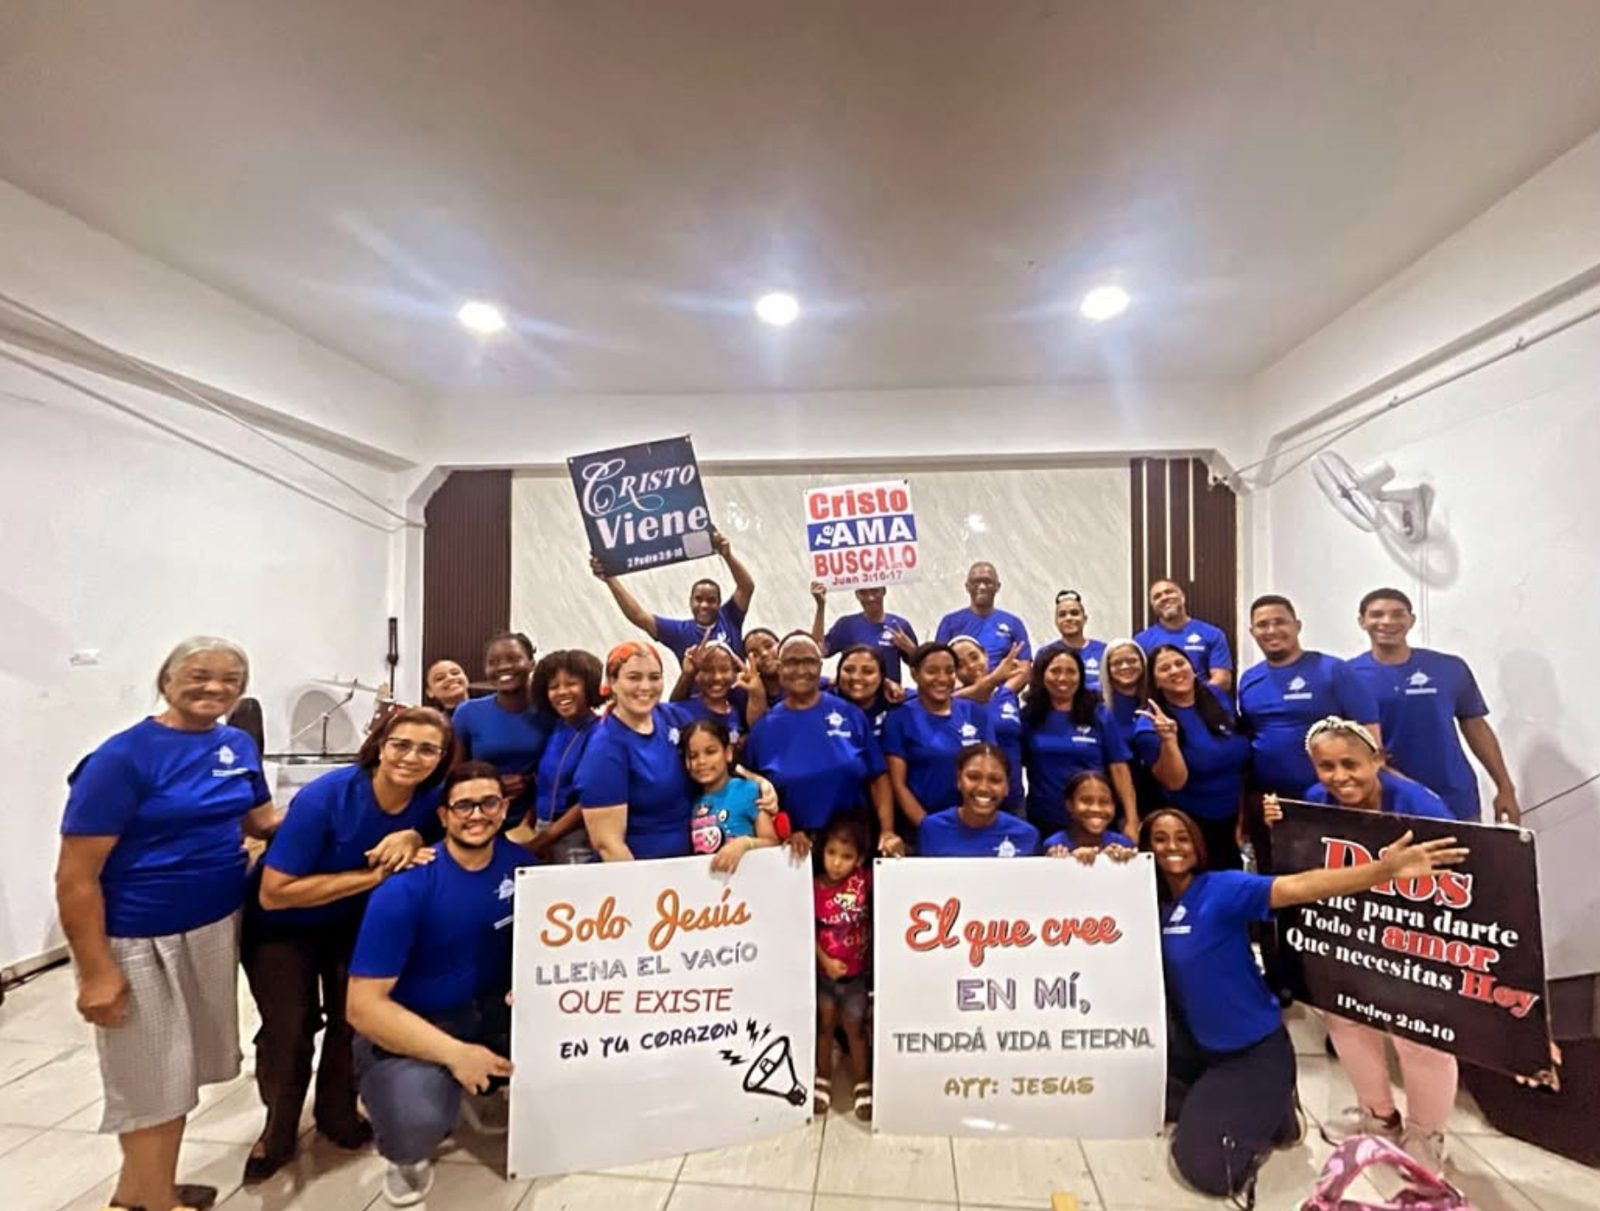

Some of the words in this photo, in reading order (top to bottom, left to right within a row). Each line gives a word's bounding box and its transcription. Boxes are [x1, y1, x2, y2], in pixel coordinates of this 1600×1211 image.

[582, 458, 696, 517] CRISTO
[809, 487, 908, 520] Cristo
[595, 506, 708, 549] Viene
[814, 525, 834, 546] Te
[831, 516, 914, 547] AMA
[814, 544, 917, 578] BUSCALO
[832, 575, 860, 586] Juan
[1320, 836, 1474, 909] Dos
[540, 896, 632, 948] Solo
[648, 887, 751, 952] Jesús
[904, 897, 960, 952] El
[963, 916, 1036, 968] que
[1040, 914, 1122, 947] cree
[1300, 907, 1352, 937] Todo
[1356, 924, 1376, 944] el
[1381, 925, 1500, 973] amor
[1364, 900, 1426, 929] para
[1433, 911, 1520, 948] darte
[535, 959, 628, 986] LLENA
[637, 955, 670, 977] EL
[681, 941, 758, 971] VACÍO
[1286, 927, 1330, 956] Que
[1335, 945, 1453, 991] necesitas
[1458, 968, 1540, 1019] Hoy
[558, 989, 625, 1015] QUE
[634, 987, 734, 1014] EXISTE
[956, 978, 1017, 1011] EN
[1034, 971, 1092, 1015] MÍ,
[560, 1039, 588, 1060] EN
[600, 1036, 630, 1058] TU
[640, 1019, 738, 1050] CORAZON
[892, 1026, 986, 1053] TENDRÁ
[996, 1029, 1051, 1051] VIDA
[944, 1076, 998, 1099] ATT:
[1010, 1076, 1095, 1096] JESUS
